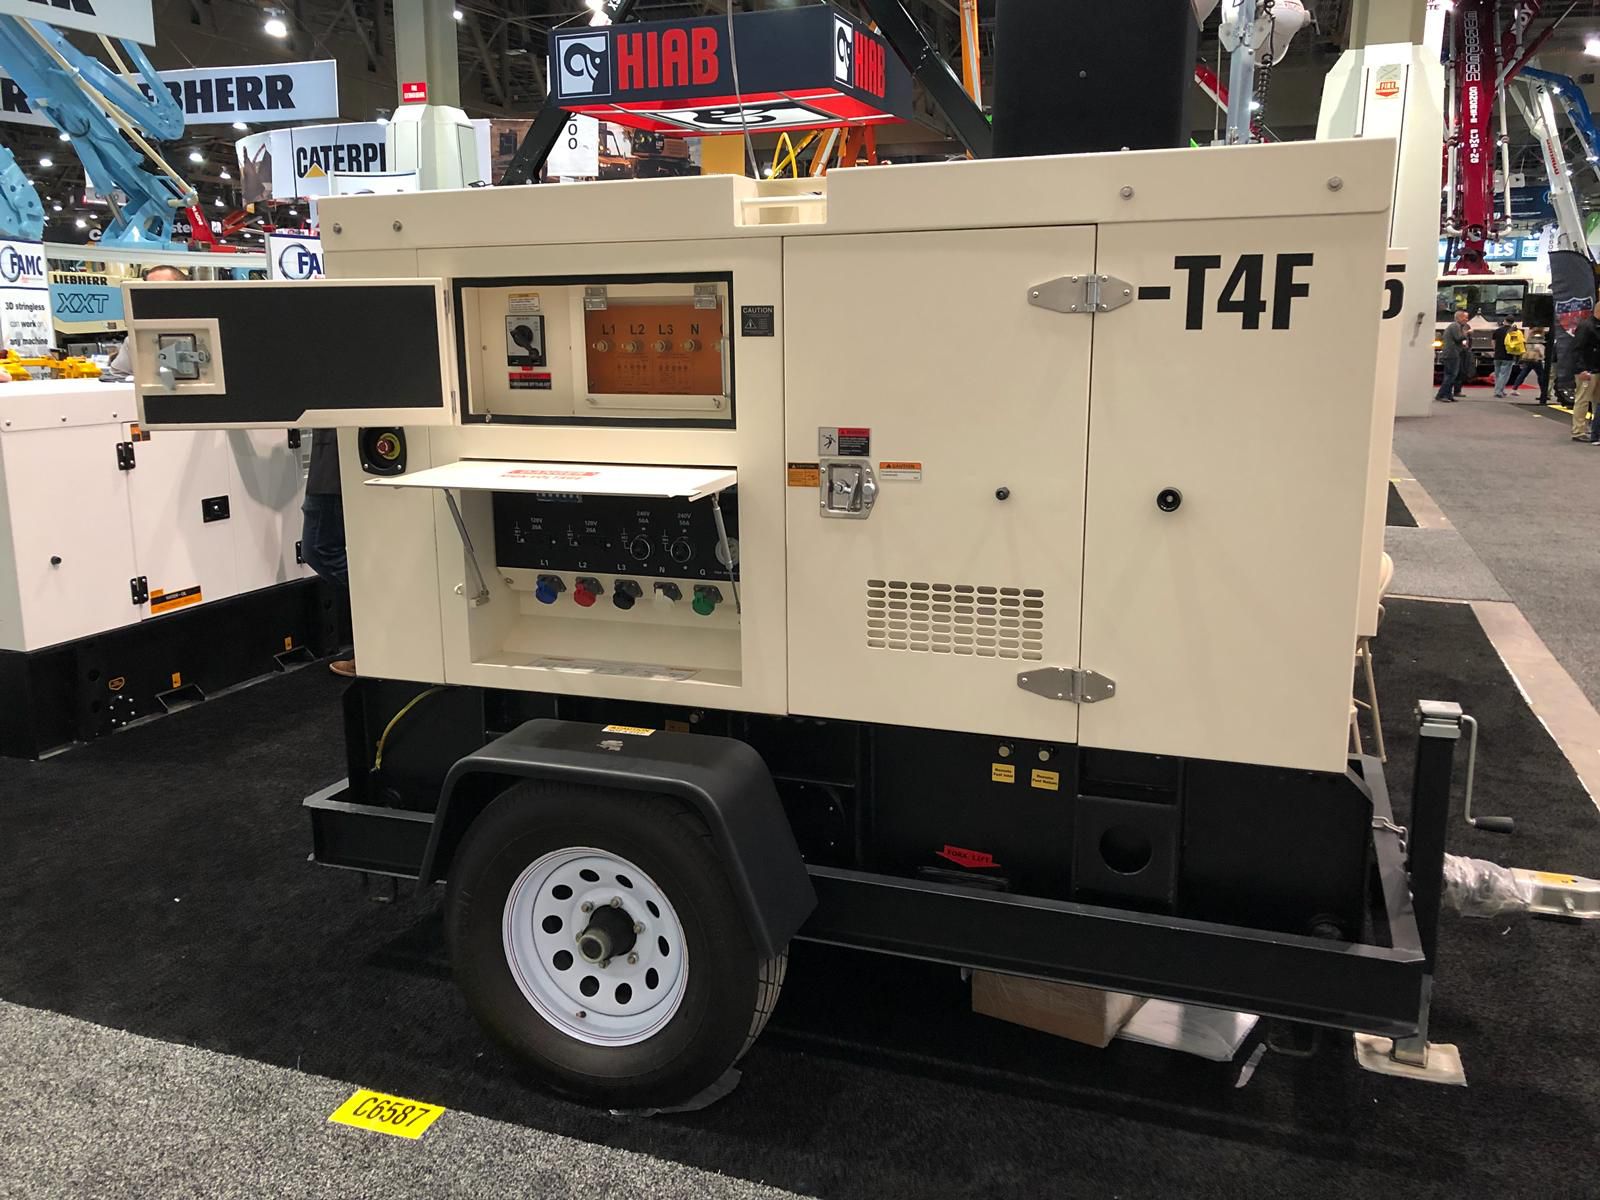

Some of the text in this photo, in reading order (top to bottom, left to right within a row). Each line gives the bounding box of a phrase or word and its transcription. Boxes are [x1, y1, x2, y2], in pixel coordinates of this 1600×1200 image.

[1464, 10, 1481, 82] EUROPEAN
[617, 27, 719, 90] HIAB
[854, 30, 886, 98] HIAB
[1470, 129, 1480, 163] PUMPING
[10, 253, 43, 276] FAMC
[298, 252, 325, 275] FA
[53, 275, 108, 286] LIEBHERR
[57, 292, 109, 314] XXT
[602, 324, 699, 335] L1 L2 L3 N
[540, 559, 549, 567] L1
[617, 563, 627, 571] L3
[352, 1096, 431, 1128] C6587
